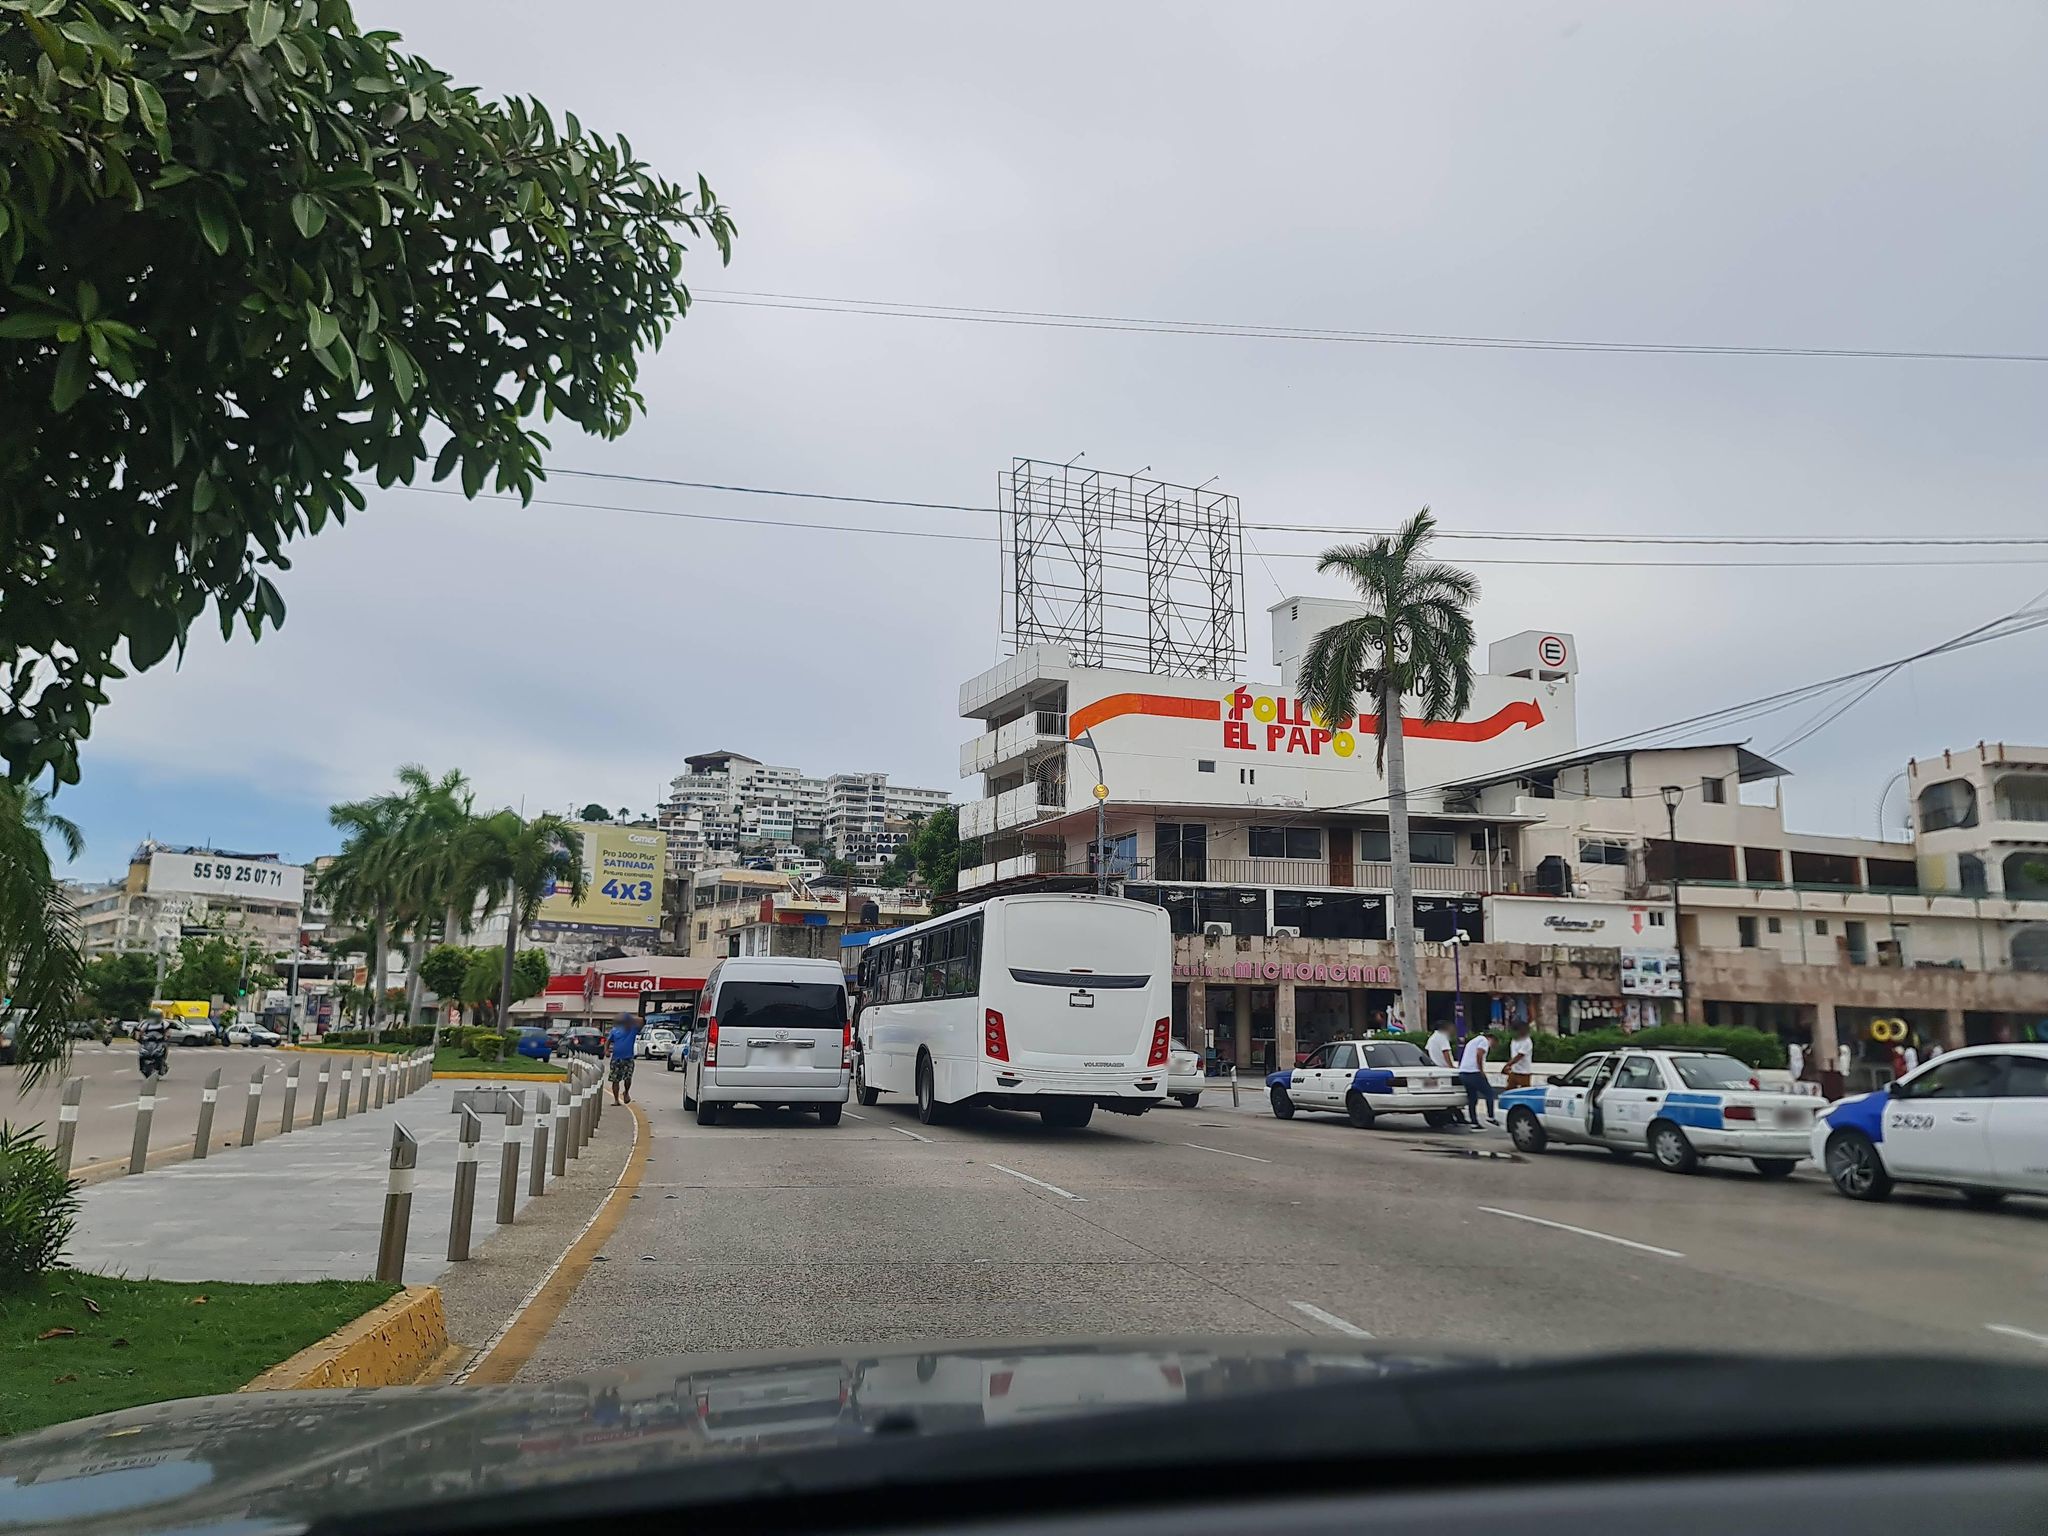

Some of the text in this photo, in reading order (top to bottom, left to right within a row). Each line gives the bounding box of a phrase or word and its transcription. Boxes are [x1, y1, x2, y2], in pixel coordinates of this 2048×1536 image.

[1545, 643, 1561, 660] E
[1224, 721, 1356, 758] EL PAPO
[628, 833, 660, 845] Comex
[602, 850, 617, 858] Pro
[618, 851, 638, 860] 1000
[603, 859, 655, 870] SATINADA
[193, 862, 282, 887] 55 59 25 07 71
[601, 878, 653, 902] 4x3
[1543, 915, 1589, 928] Taberna
[1234, 961, 1391, 983] MICHOACANA
[607, 980, 653, 991] CIRCLE K
